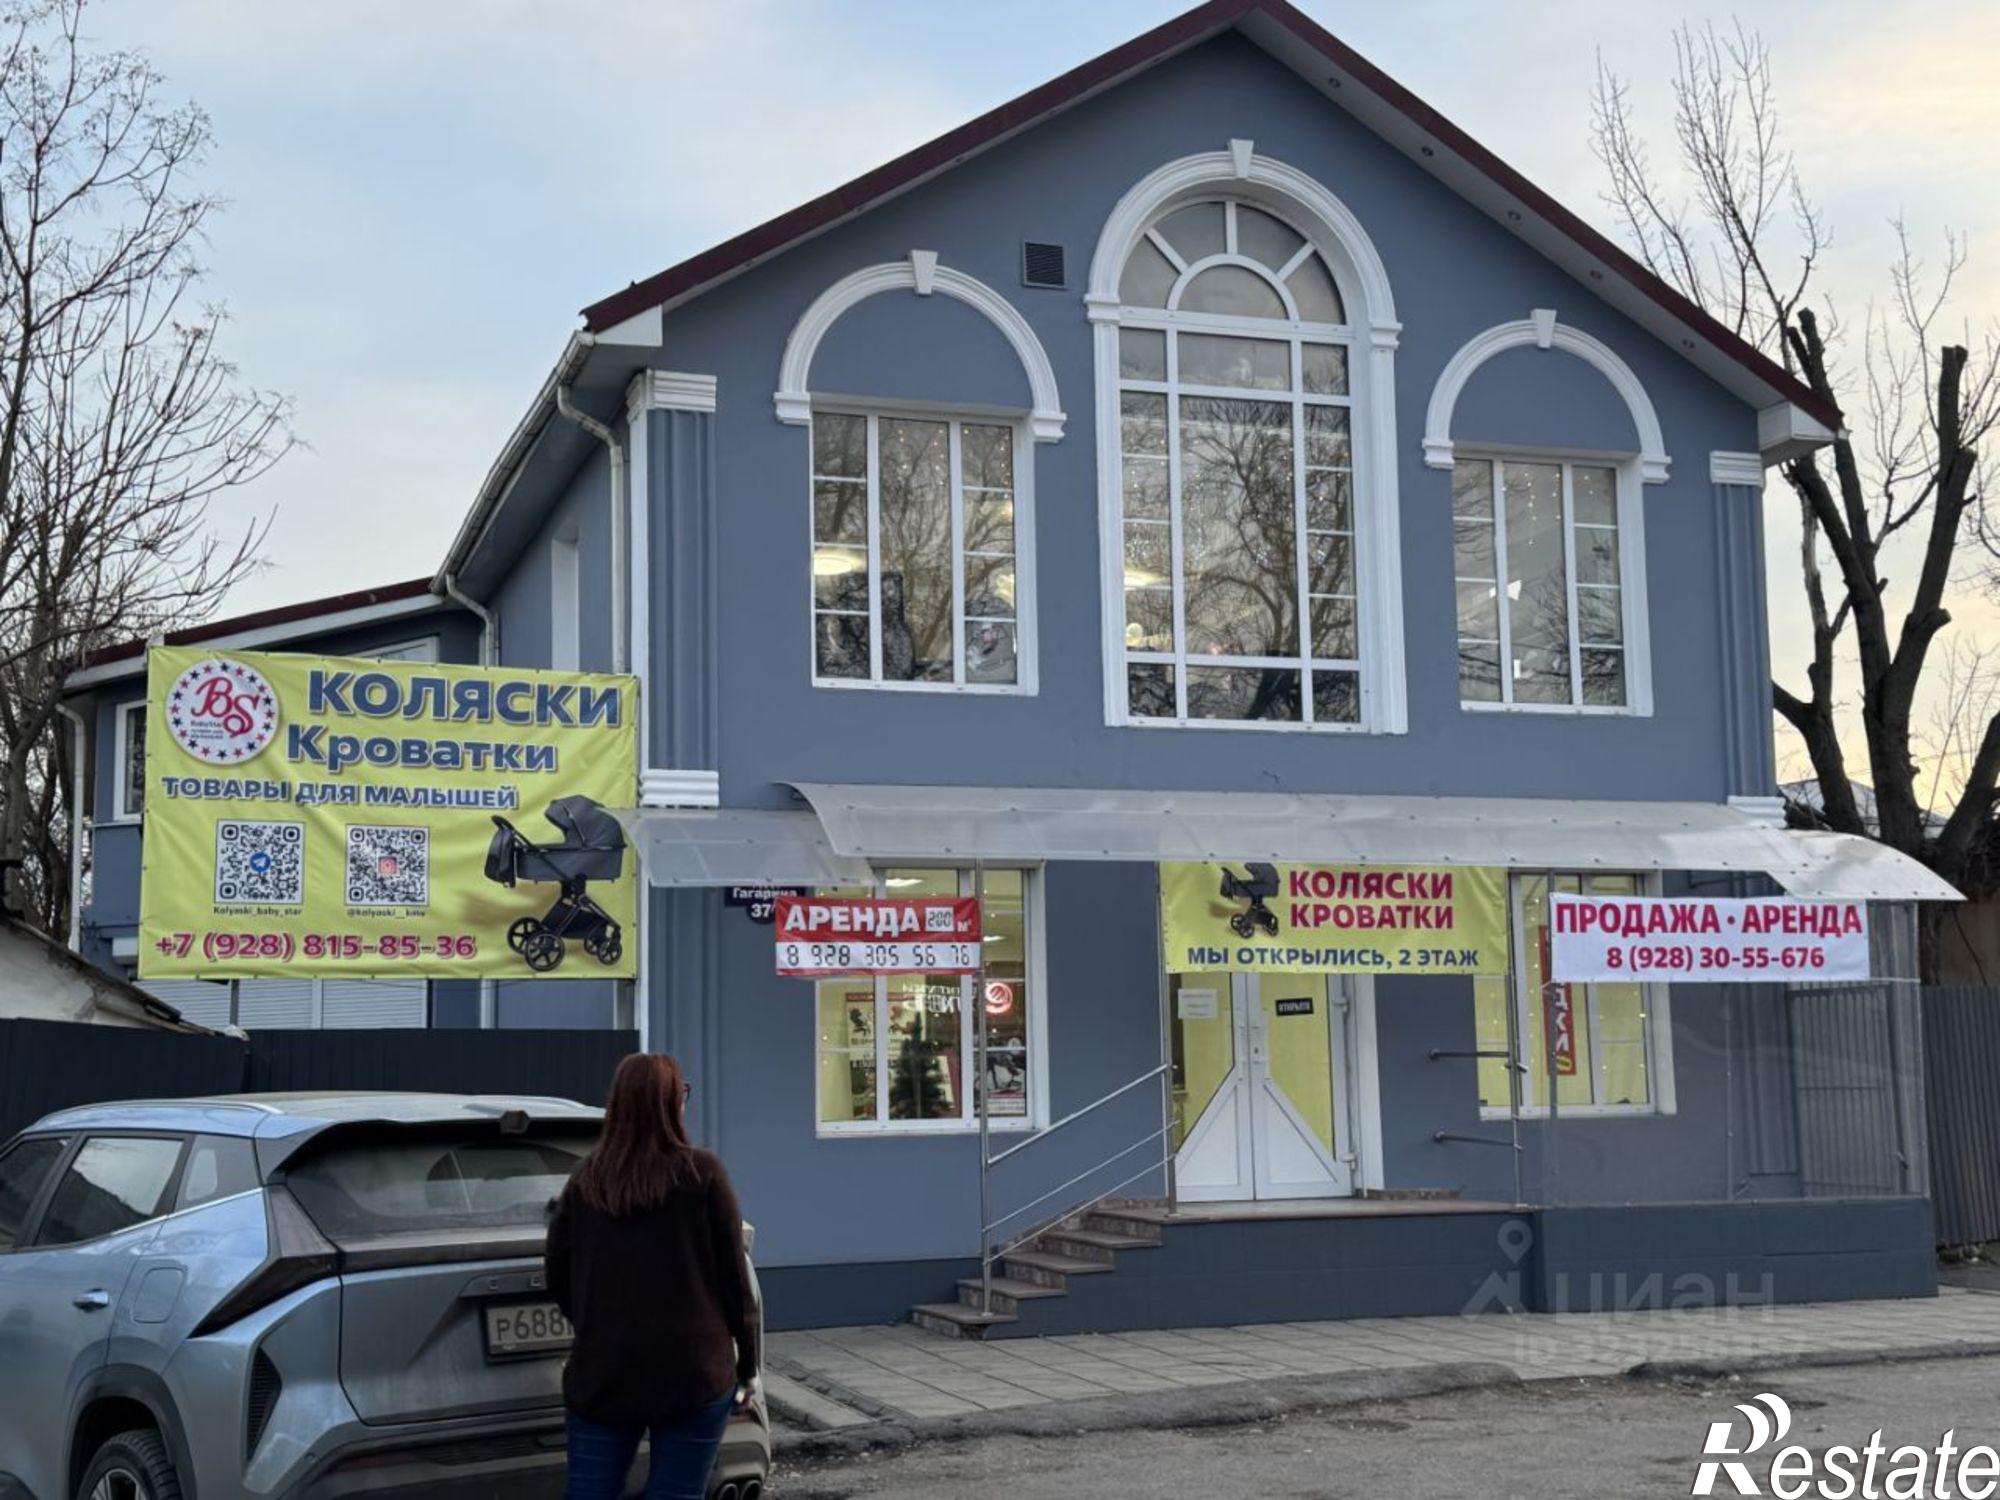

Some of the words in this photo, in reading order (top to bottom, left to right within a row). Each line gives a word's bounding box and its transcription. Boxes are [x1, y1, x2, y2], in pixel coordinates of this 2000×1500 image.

[309, 670, 620, 727] КОЛЯСКИ
[287, 724, 558, 772] Кроватки
[162, 777, 289, 800] ТОВАРЫ
[296, 784, 357, 806] ДЛЯ
[366, 785, 518, 809] МАЛЫШЕЙ
[733, 887, 797, 900] Гагарина
[1289, 870, 1453, 899] КОЛЯСКИ
[784, 905, 920, 937] АРЕНДА
[927, 912, 952, 927] 200
[1290, 904, 1453, 929] КРОВАТКИ
[1556, 903, 1720, 937] ПРОДАЖА
[1742, 904, 1862, 937] АРЕНДА
[155, 934, 194, 957] +7
[203, 933, 294, 960] (928)
[303, 935, 476, 958] 815-85-36
[787, 945, 799, 966] 8
[811, 945, 850, 966] 928
[866, 945, 899, 966] 305
[912, 946, 936, 966] 56
[950, 945, 970, 966] 76
[1188, 947, 1228, 965] МЫ
[1236, 948, 1393, 969] ОТКРЫЛИСЬ,
[1399, 949, 1411, 964] 2
[1417, 950, 1479, 966] ЭТАЖ
[1607, 948, 1622, 968] 8
[1629, 946, 1694, 972] (928)
[1700, 947, 1825, 968] 30-55-676
